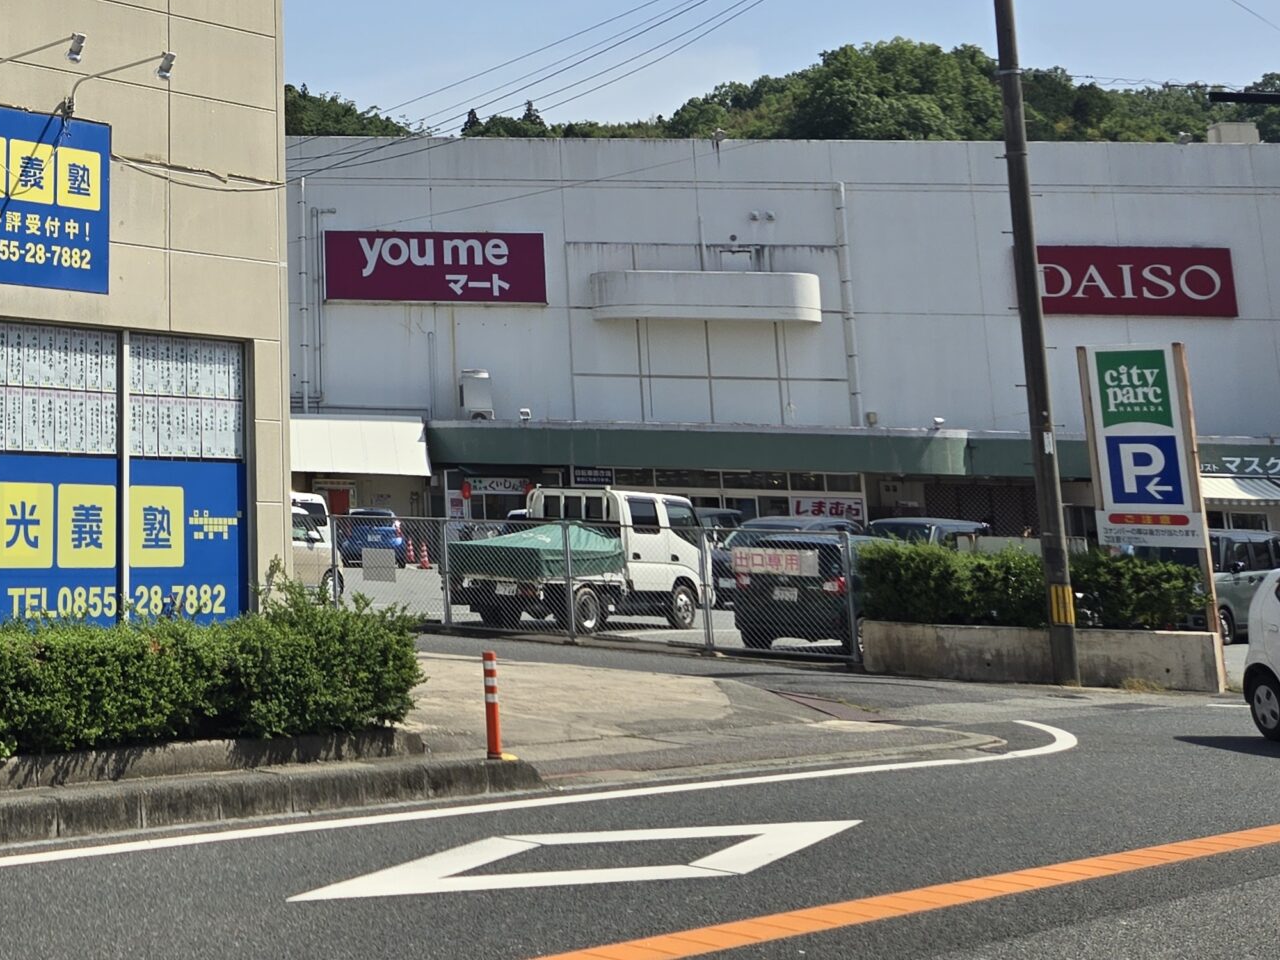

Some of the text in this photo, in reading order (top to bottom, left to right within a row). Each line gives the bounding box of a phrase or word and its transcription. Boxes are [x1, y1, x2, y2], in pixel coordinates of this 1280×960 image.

[445, 273, 510, 296] マート
[1038, 263, 1221, 301] DAISO
[1104, 365, 1159, 388] city
[1106, 386, 1162, 412] parc
[1119, 442, 1166, 493] P
[795, 500, 862, 517] しまむら
[735, 552, 799, 570] 出口専用
